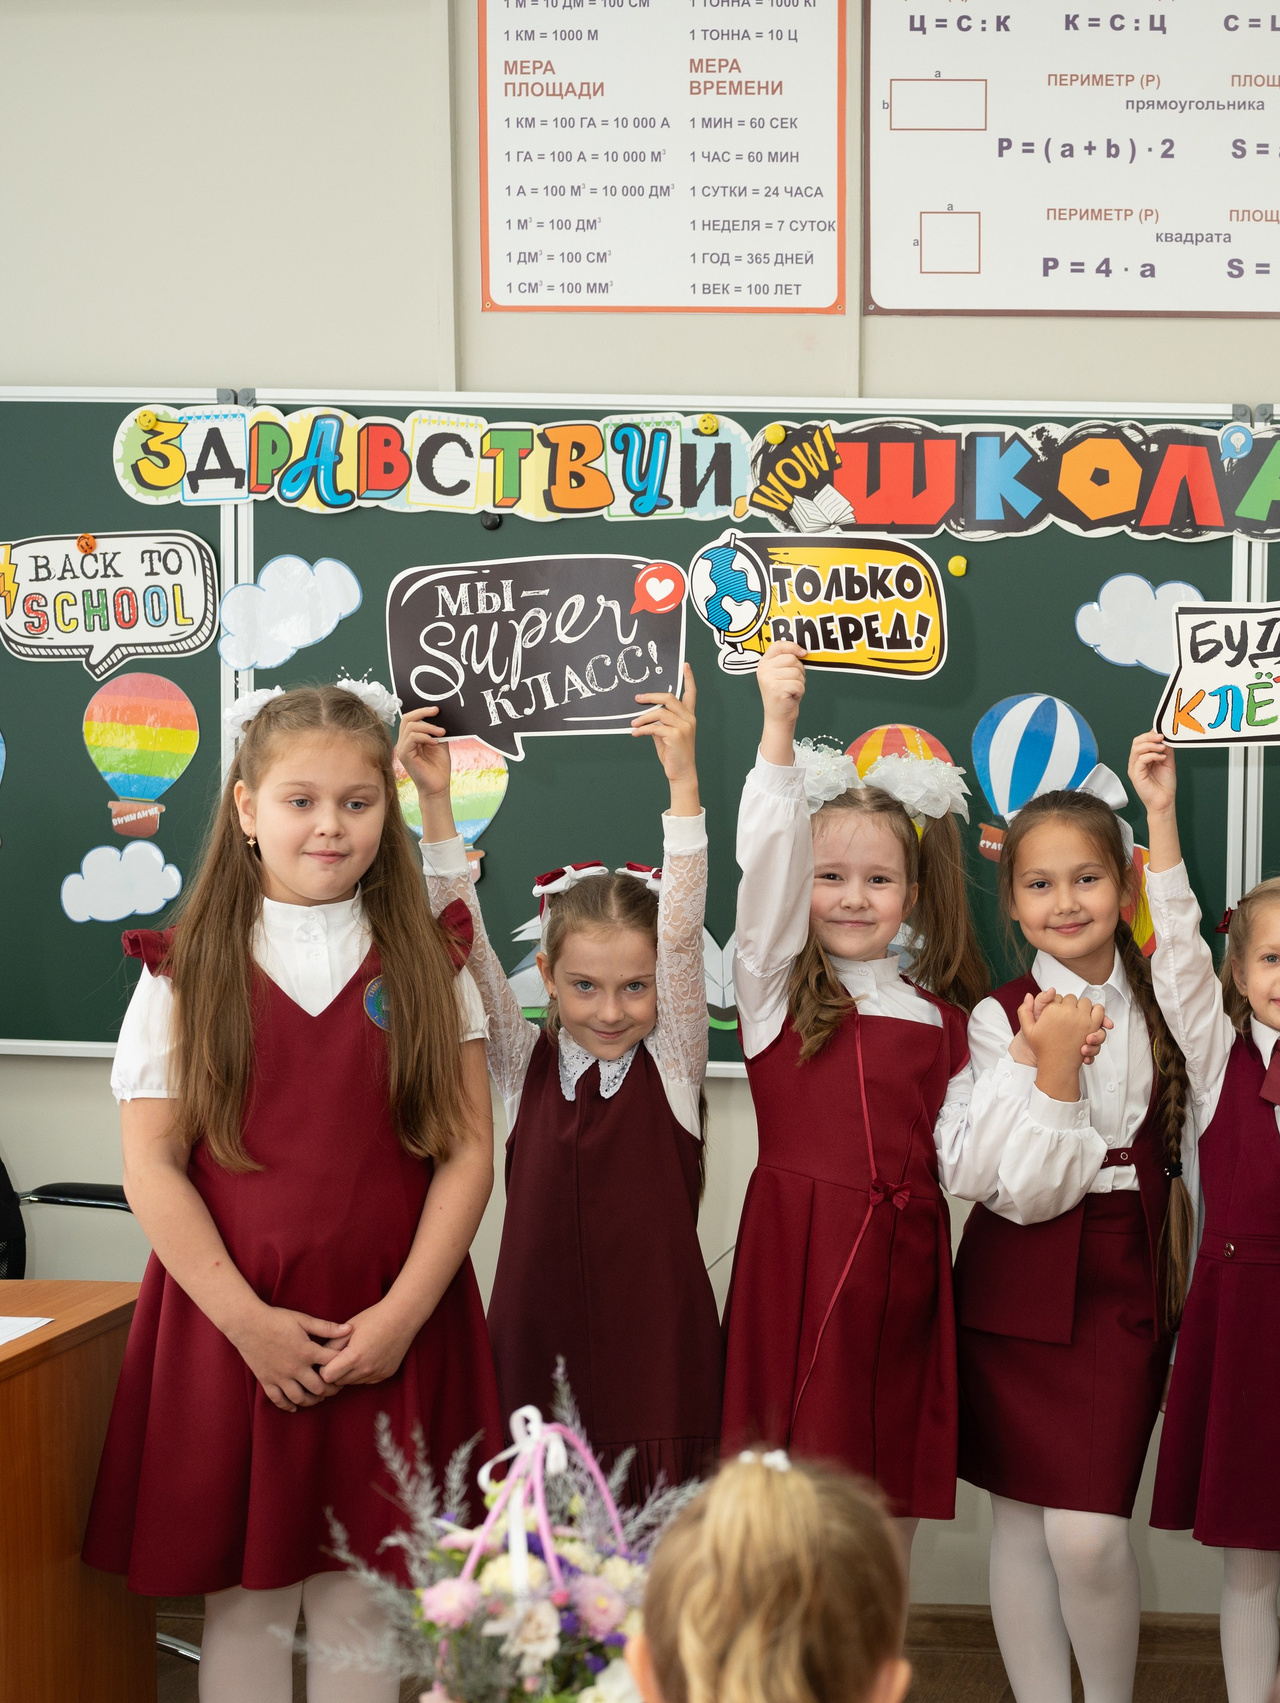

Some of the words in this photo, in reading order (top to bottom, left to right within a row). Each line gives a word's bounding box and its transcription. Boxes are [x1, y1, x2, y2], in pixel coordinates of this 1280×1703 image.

[515, 29, 535, 42] КМ
[552, 29, 583, 42] 1000
[587, 29, 599, 41] М
[700, 28, 752, 41] ТОННА
[768, 29, 784, 41] 10
[787, 29, 798, 44] Ц
[503, 59, 556, 76] МЕРА
[689, 58, 742, 74] МЕРА
[1047, 73, 1136, 87] ПЕРИМЕТР
[504, 81, 605, 100] ПЛОЩАДИ
[689, 80, 783, 96] ВРЕМЕНИ
[1125, 99, 1265, 114] прямоугольника
[516, 116, 536, 129] КМ
[552, 116, 576, 129] 100
[580, 116, 597, 129] ГА
[613, 116, 629, 129] 10
[632, 116, 657, 129] 000
[701, 117, 733, 129] МИН
[749, 117, 766, 129] 60
[769, 117, 799, 129] СЕК
[516, 150, 534, 163] ГА
[549, 150, 573, 163] 100
[603, 150, 619, 163] 10
[622, 150, 647, 163] 000
[701, 150, 731, 163] ЧАС
[747, 151, 764, 163] 60
[767, 151, 800, 163] МИН
[543, 184, 566, 197] 100
[602, 184, 618, 197] 10
[621, 185, 645, 197] 000
[701, 185, 748, 198] СУТКИ
[763, 185, 780, 198] 24
[783, 185, 824, 198] ЧАСА
[1046, 207, 1134, 222] ПЕРИМЕТР
[548, 218, 572, 231] 100
[701, 219, 761, 234] НЕДЕЛЯ
[777, 219, 785, 232] 7
[789, 219, 837, 232] СУТОК
[1155, 232, 1232, 247] квадрата
[559, 251, 582, 264] 100
[702, 252, 731, 267] ГОД
[746, 252, 771, 265] 365
[773, 250, 814, 267] ДНЕЙ
[559, 282, 582, 294] 100
[702, 283, 730, 295] ВЕК
[746, 283, 770, 296] 100
[773, 283, 802, 296] ЛЕТ
[752, 423, 843, 512] WOW!
[28, 551, 124, 582] BACK
[141, 548, 183, 577] TO
[771, 563, 923, 604] ТОЛЬКО
[23, 583, 195, 635] SCHOOL
[771, 610, 932, 651] ВПЕРЕД!
[409, 594, 639, 707] Super
[480, 640, 663, 727] КЛАСС!
